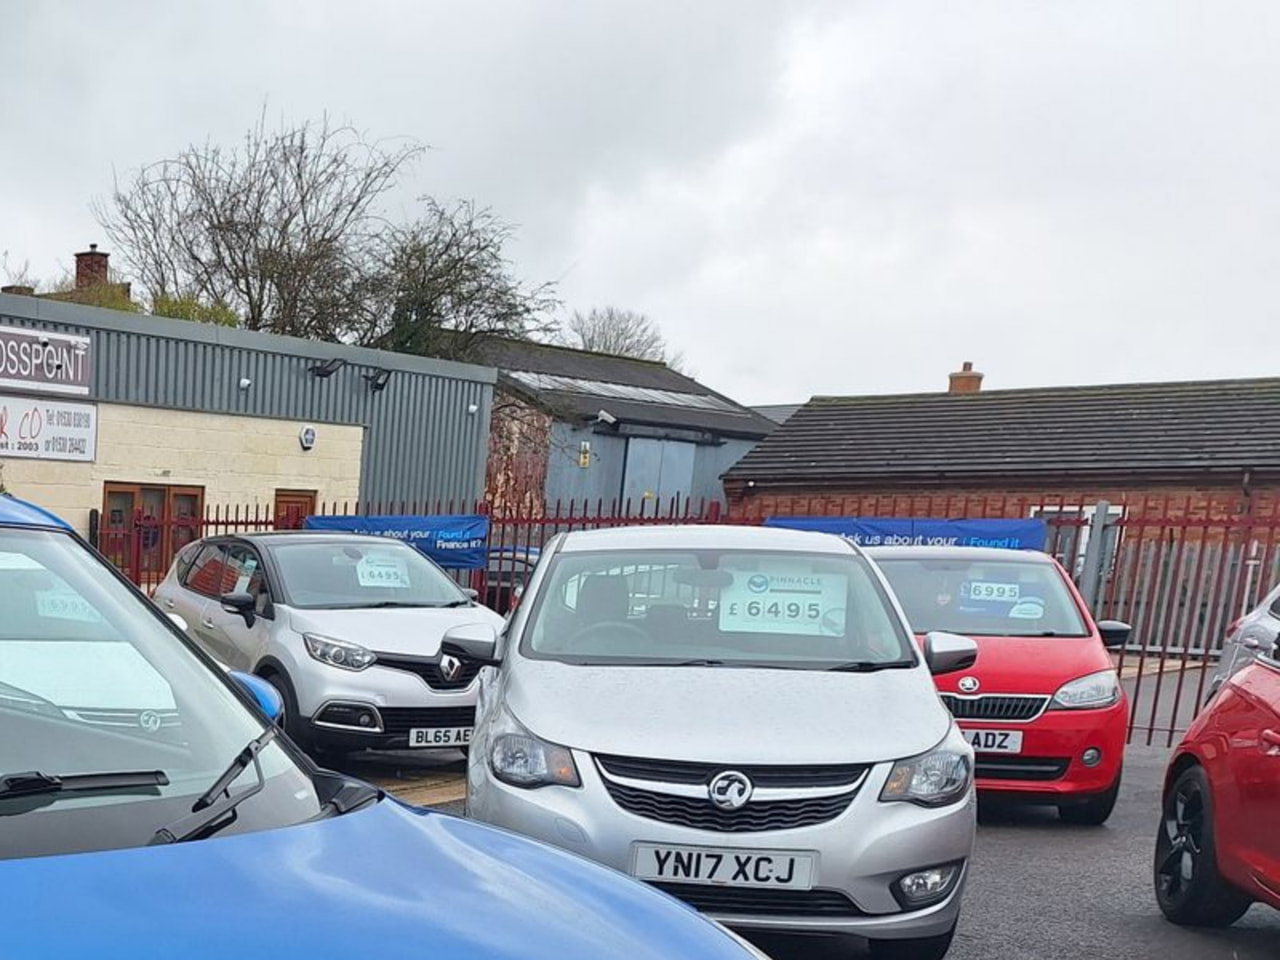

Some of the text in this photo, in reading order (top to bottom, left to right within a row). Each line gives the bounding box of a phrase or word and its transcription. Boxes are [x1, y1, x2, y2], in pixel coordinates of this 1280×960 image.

[19, 407, 42, 439] CO
[17, 441, 39, 451] 2003
[436, 540, 468, 549] Finance
[865, 535, 881, 545] us
[970, 536, 1007, 548] Found
[415, 729, 451, 743] BL65
[971, 731, 1010, 750] ADZ
[654, 850, 795, 883] YN17 XCJ
